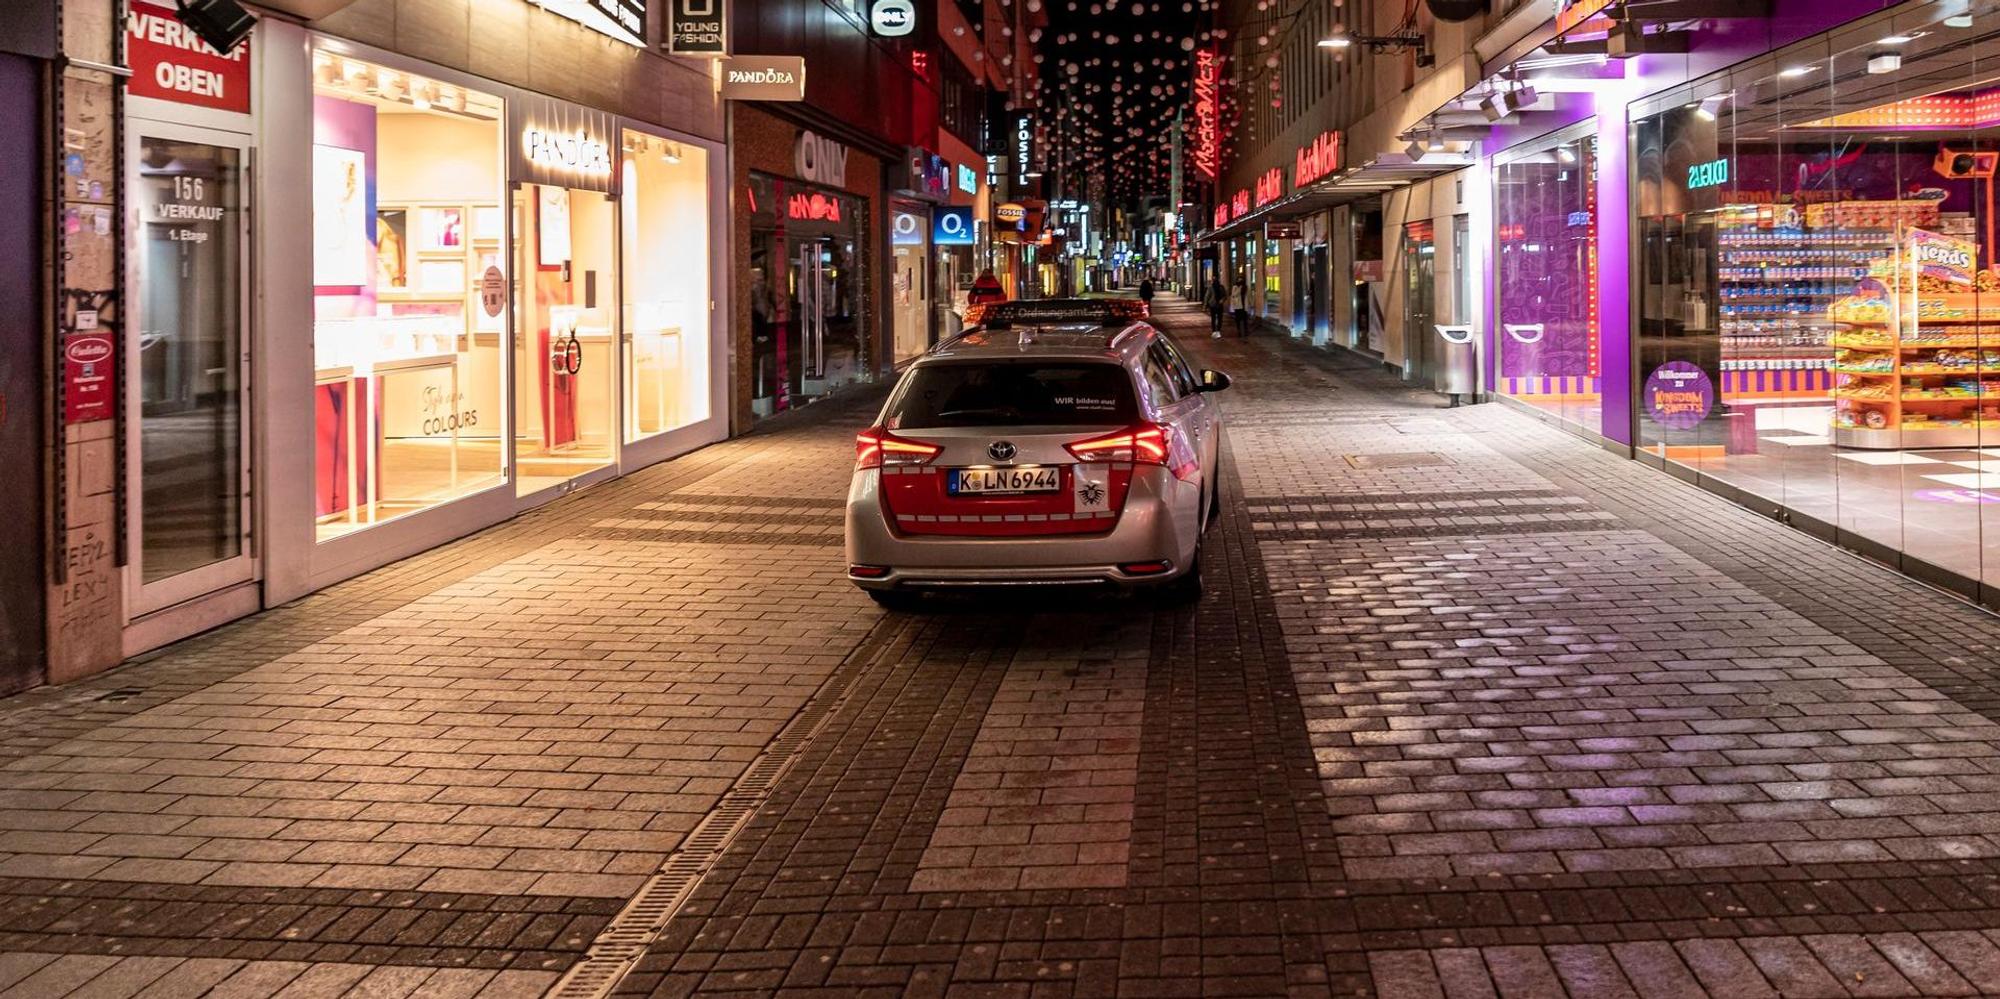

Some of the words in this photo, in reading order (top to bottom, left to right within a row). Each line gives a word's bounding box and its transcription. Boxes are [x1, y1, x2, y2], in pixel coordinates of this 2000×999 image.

[673, 33, 722, 43] FASHION
[676, 22, 719, 32] YOUNG
[155, 61, 224, 98] OBEN
[796, 130, 849, 188] ONLY
[1018, 118, 1029, 185] FOSSIL
[174, 176, 204, 201] 156
[159, 203, 224, 220] VERKAUF
[942, 213, 967, 238] O2
[1018, 304, 1088, 319] Ordnungsamt
[423, 409, 478, 436] COLOURS
[960, 472, 972, 491] K
[984, 472, 1008, 490] LN
[1011, 470, 1057, 489] 6944
